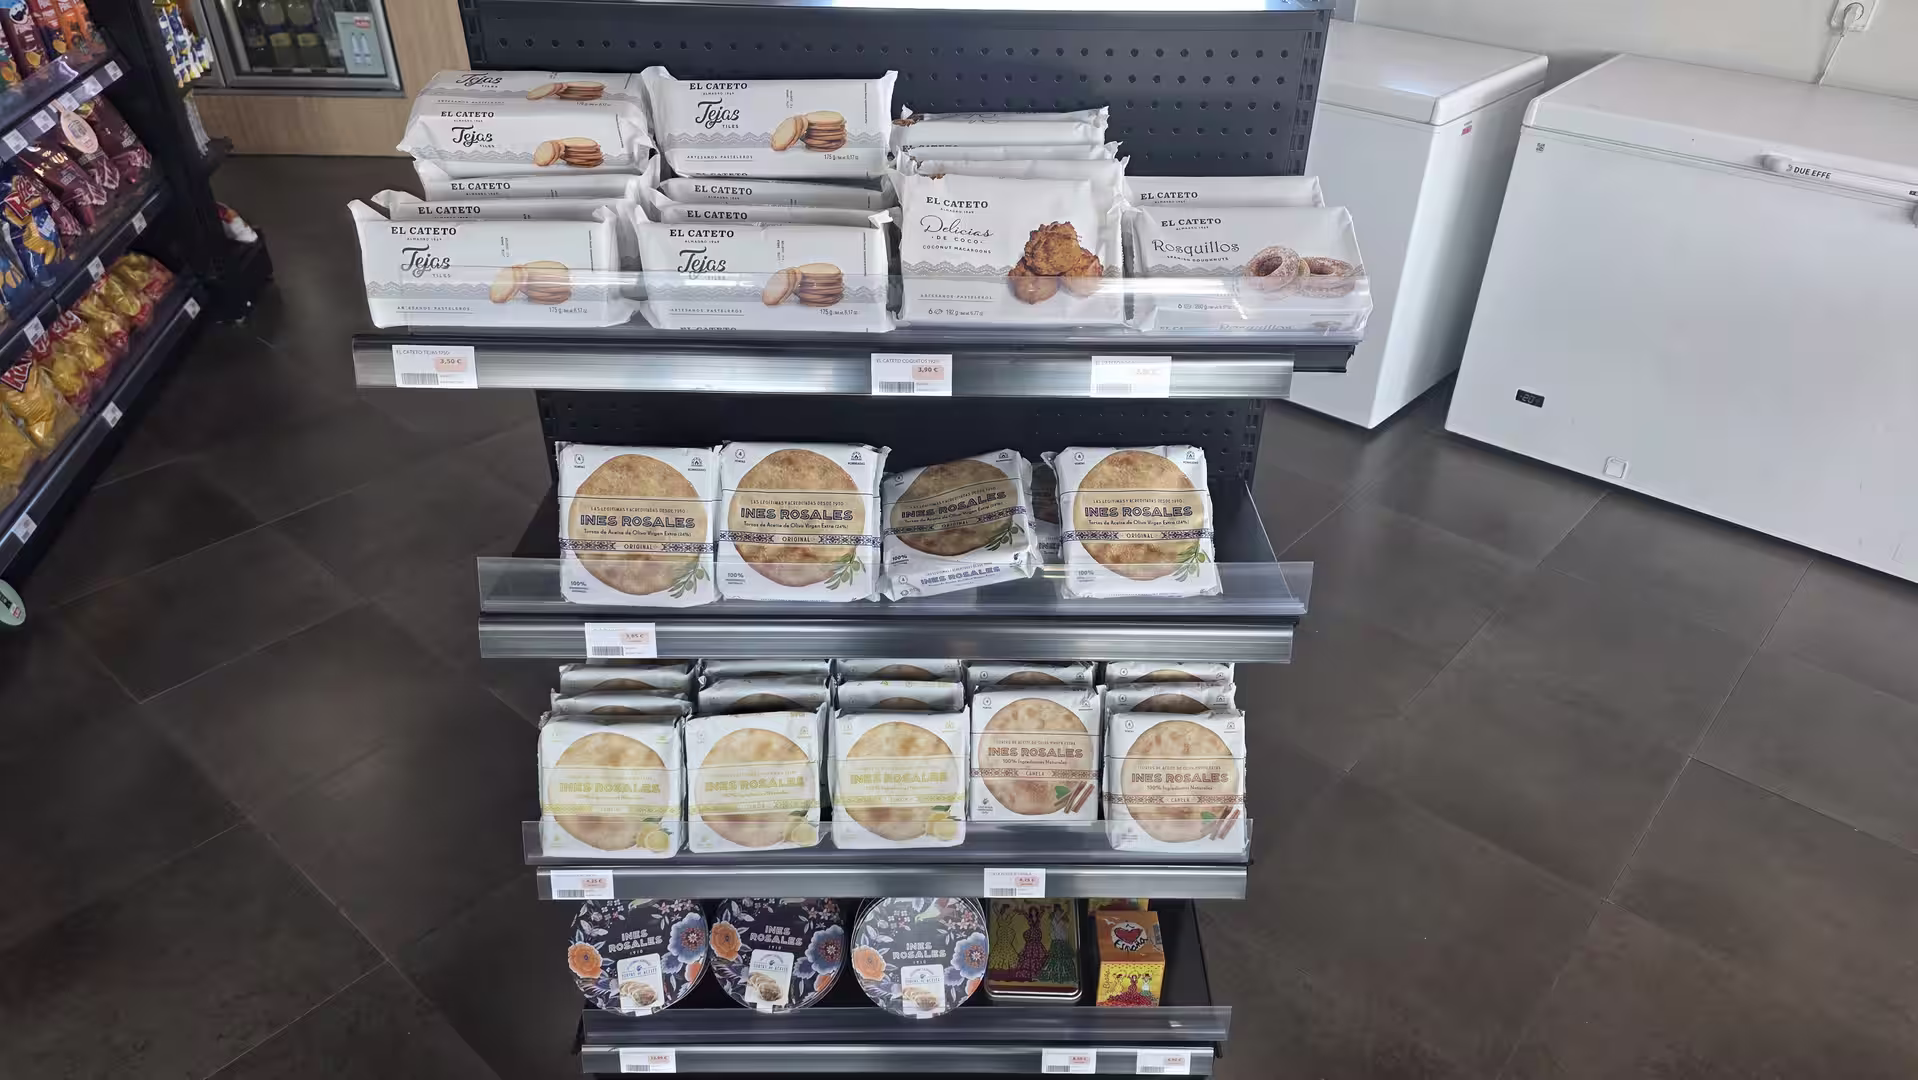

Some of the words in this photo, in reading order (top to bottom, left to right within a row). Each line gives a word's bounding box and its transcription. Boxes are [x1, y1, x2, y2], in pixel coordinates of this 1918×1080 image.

[456, 72, 503, 87] Tejas
[705, 82, 748, 90] CATETO
[695, 97, 740, 129] Tejas
[451, 124, 493, 148] Tejas
[1793, 166, 1811, 176] DUE
[1811, 169, 1832, 180] EFFE
[467, 182, 511, 190] CATETO
[694, 185, 708, 193] EL
[710, 186, 753, 195] CATETO
[1157, 191, 1198, 199] CATETO
[926, 196, 941, 205] EL
[943, 199, 989, 208] CATETO
[418, 206, 433, 214] EL
[435, 206, 481, 214] CATETO
[687, 210, 701, 218] EL
[704, 211, 748, 220] CATETO
[920, 214, 994, 237] Delicias
[1178, 218, 1222, 226] CATETO
[391, 226, 406, 235] EL
[409, 226, 457, 235] CATETO
[669, 229, 685, 237] EL
[687, 229, 735, 238] CATETO
[954, 246, 992, 254] MACAROONS
[1151, 239, 1240, 257] Rosquillos
[401, 244, 451, 278] Tejas
[677, 246, 727, 280] Tejas
[901, 508, 936, 518] INES
[938, 491, 1007, 515] ROSALES
[740, 507, 776, 520] INES
[780, 509, 854, 521] ROSALES
[1084, 506, 1119, 518] INES
[1122, 506, 1193, 518] ROSALES
[580, 514, 618, 526] INES
[621, 516, 696, 529] ROSALES
[920, 575, 947, 585] INES
[947, 566, 1001, 581] ROSALES
[987, 747, 1018, 757] INES
[1020, 747, 1084, 758] ROSALES
[1131, 772, 1162, 783] INES
[1165, 773, 1229, 783] ROSALES
[705, 780, 738, 792] INES
[740, 776, 804, 790] ROSALES
[621, 928, 649, 942] INES
[765, 925, 791, 936] INES
[608, 935, 663, 953] ROSALES
[749, 932, 803, 947] ROSALES
[906, 941, 933, 951] INES
[892, 949, 947, 960] ROSALES
